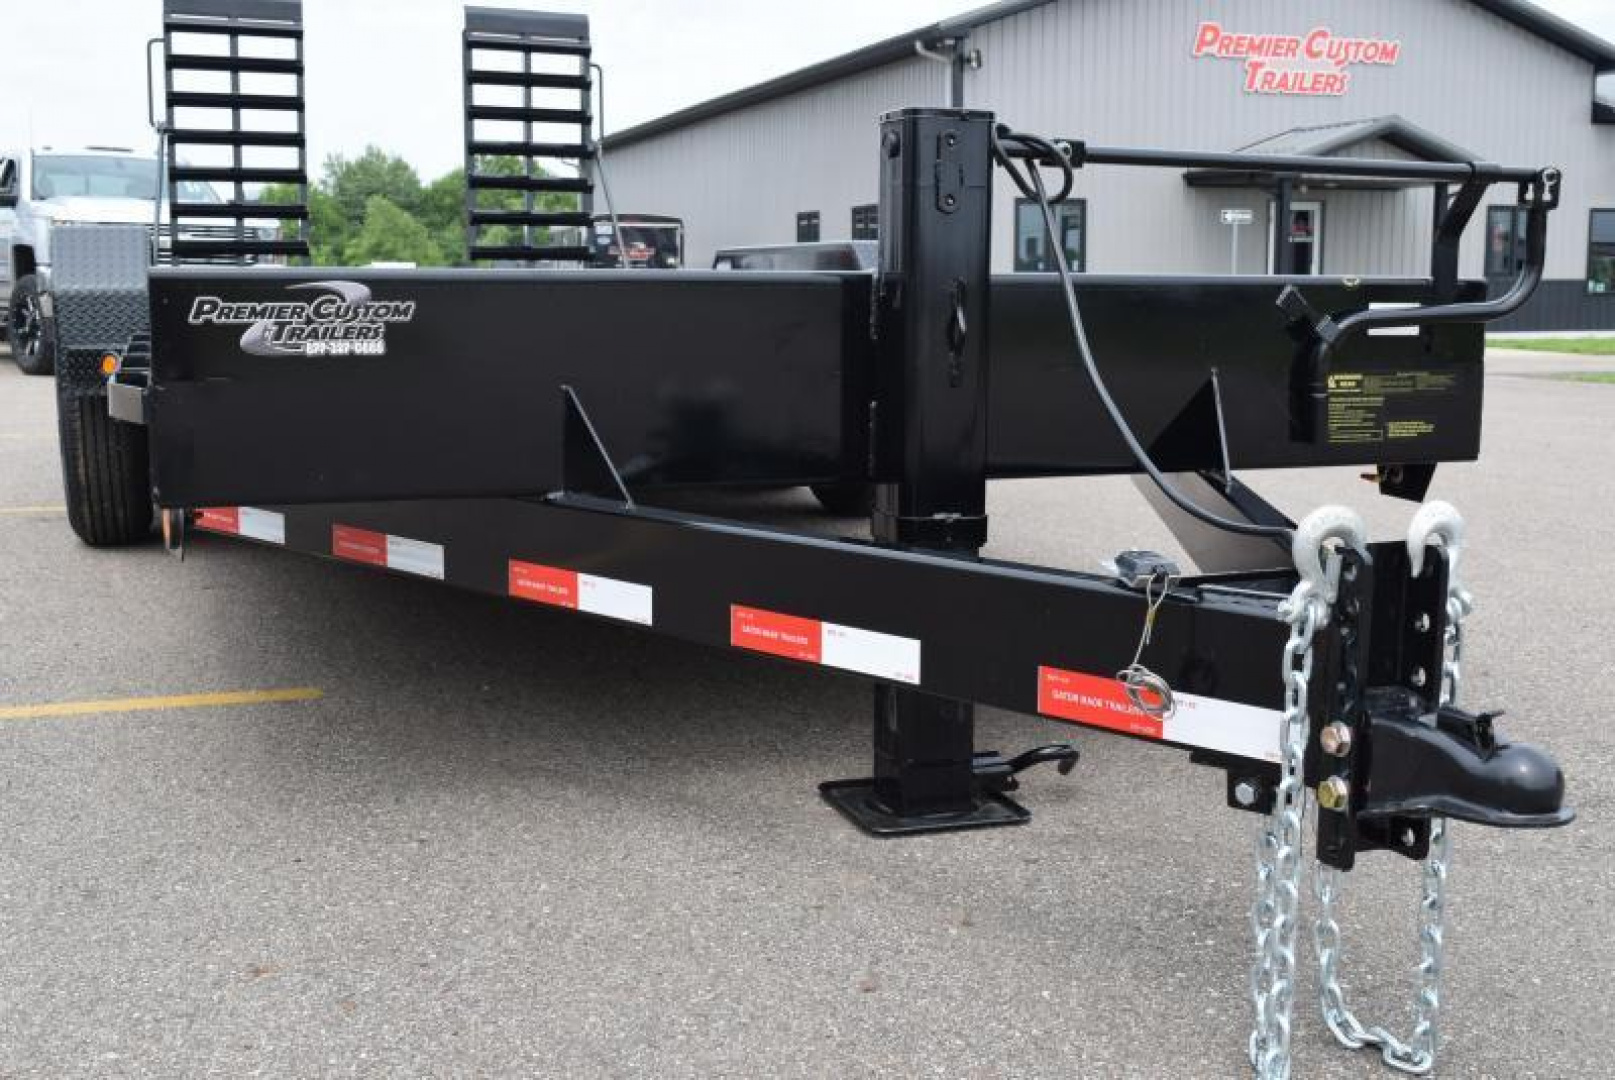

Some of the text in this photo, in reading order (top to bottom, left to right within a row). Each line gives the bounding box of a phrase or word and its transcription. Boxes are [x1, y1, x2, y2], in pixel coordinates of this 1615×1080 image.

[1193, 22, 1400, 66] PREMIER CUSTOM
[1244, 59, 1348, 95] TRAILERS
[188, 294, 415, 325] PREMIER CUSTOM
[269, 320, 386, 344] TRAILERS
